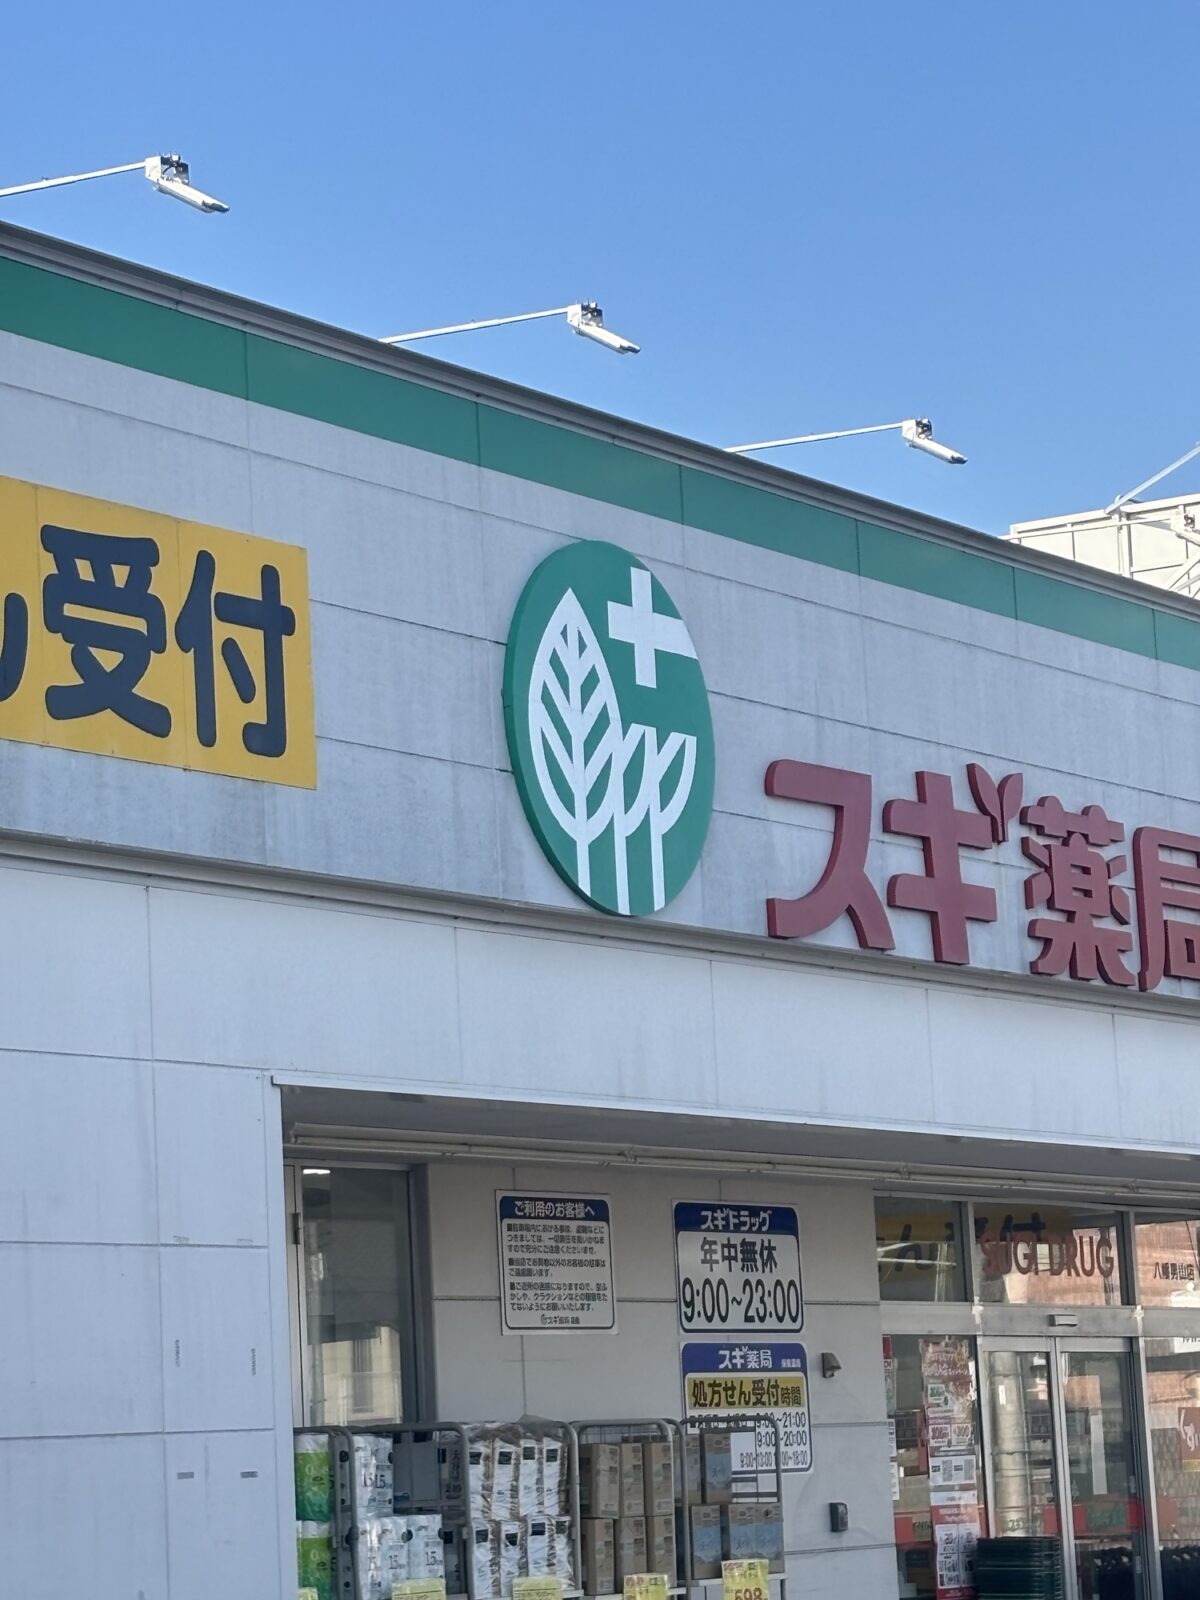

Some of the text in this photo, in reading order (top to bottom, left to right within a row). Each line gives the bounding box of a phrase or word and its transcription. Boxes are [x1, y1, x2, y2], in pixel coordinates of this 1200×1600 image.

[0, 524, 296, 758] 受付
[764, 758, 1200, 991] スギ薬局
[514, 1200, 595, 1218] ご利用のお客様へ
[700, 1208, 772, 1231] スギドラッグ
[700, 1236, 778, 1274] 年中無休
[1049, 1234, 1115, 1278] DRUG
[719, 1345, 772, 1369] スギ薬局
